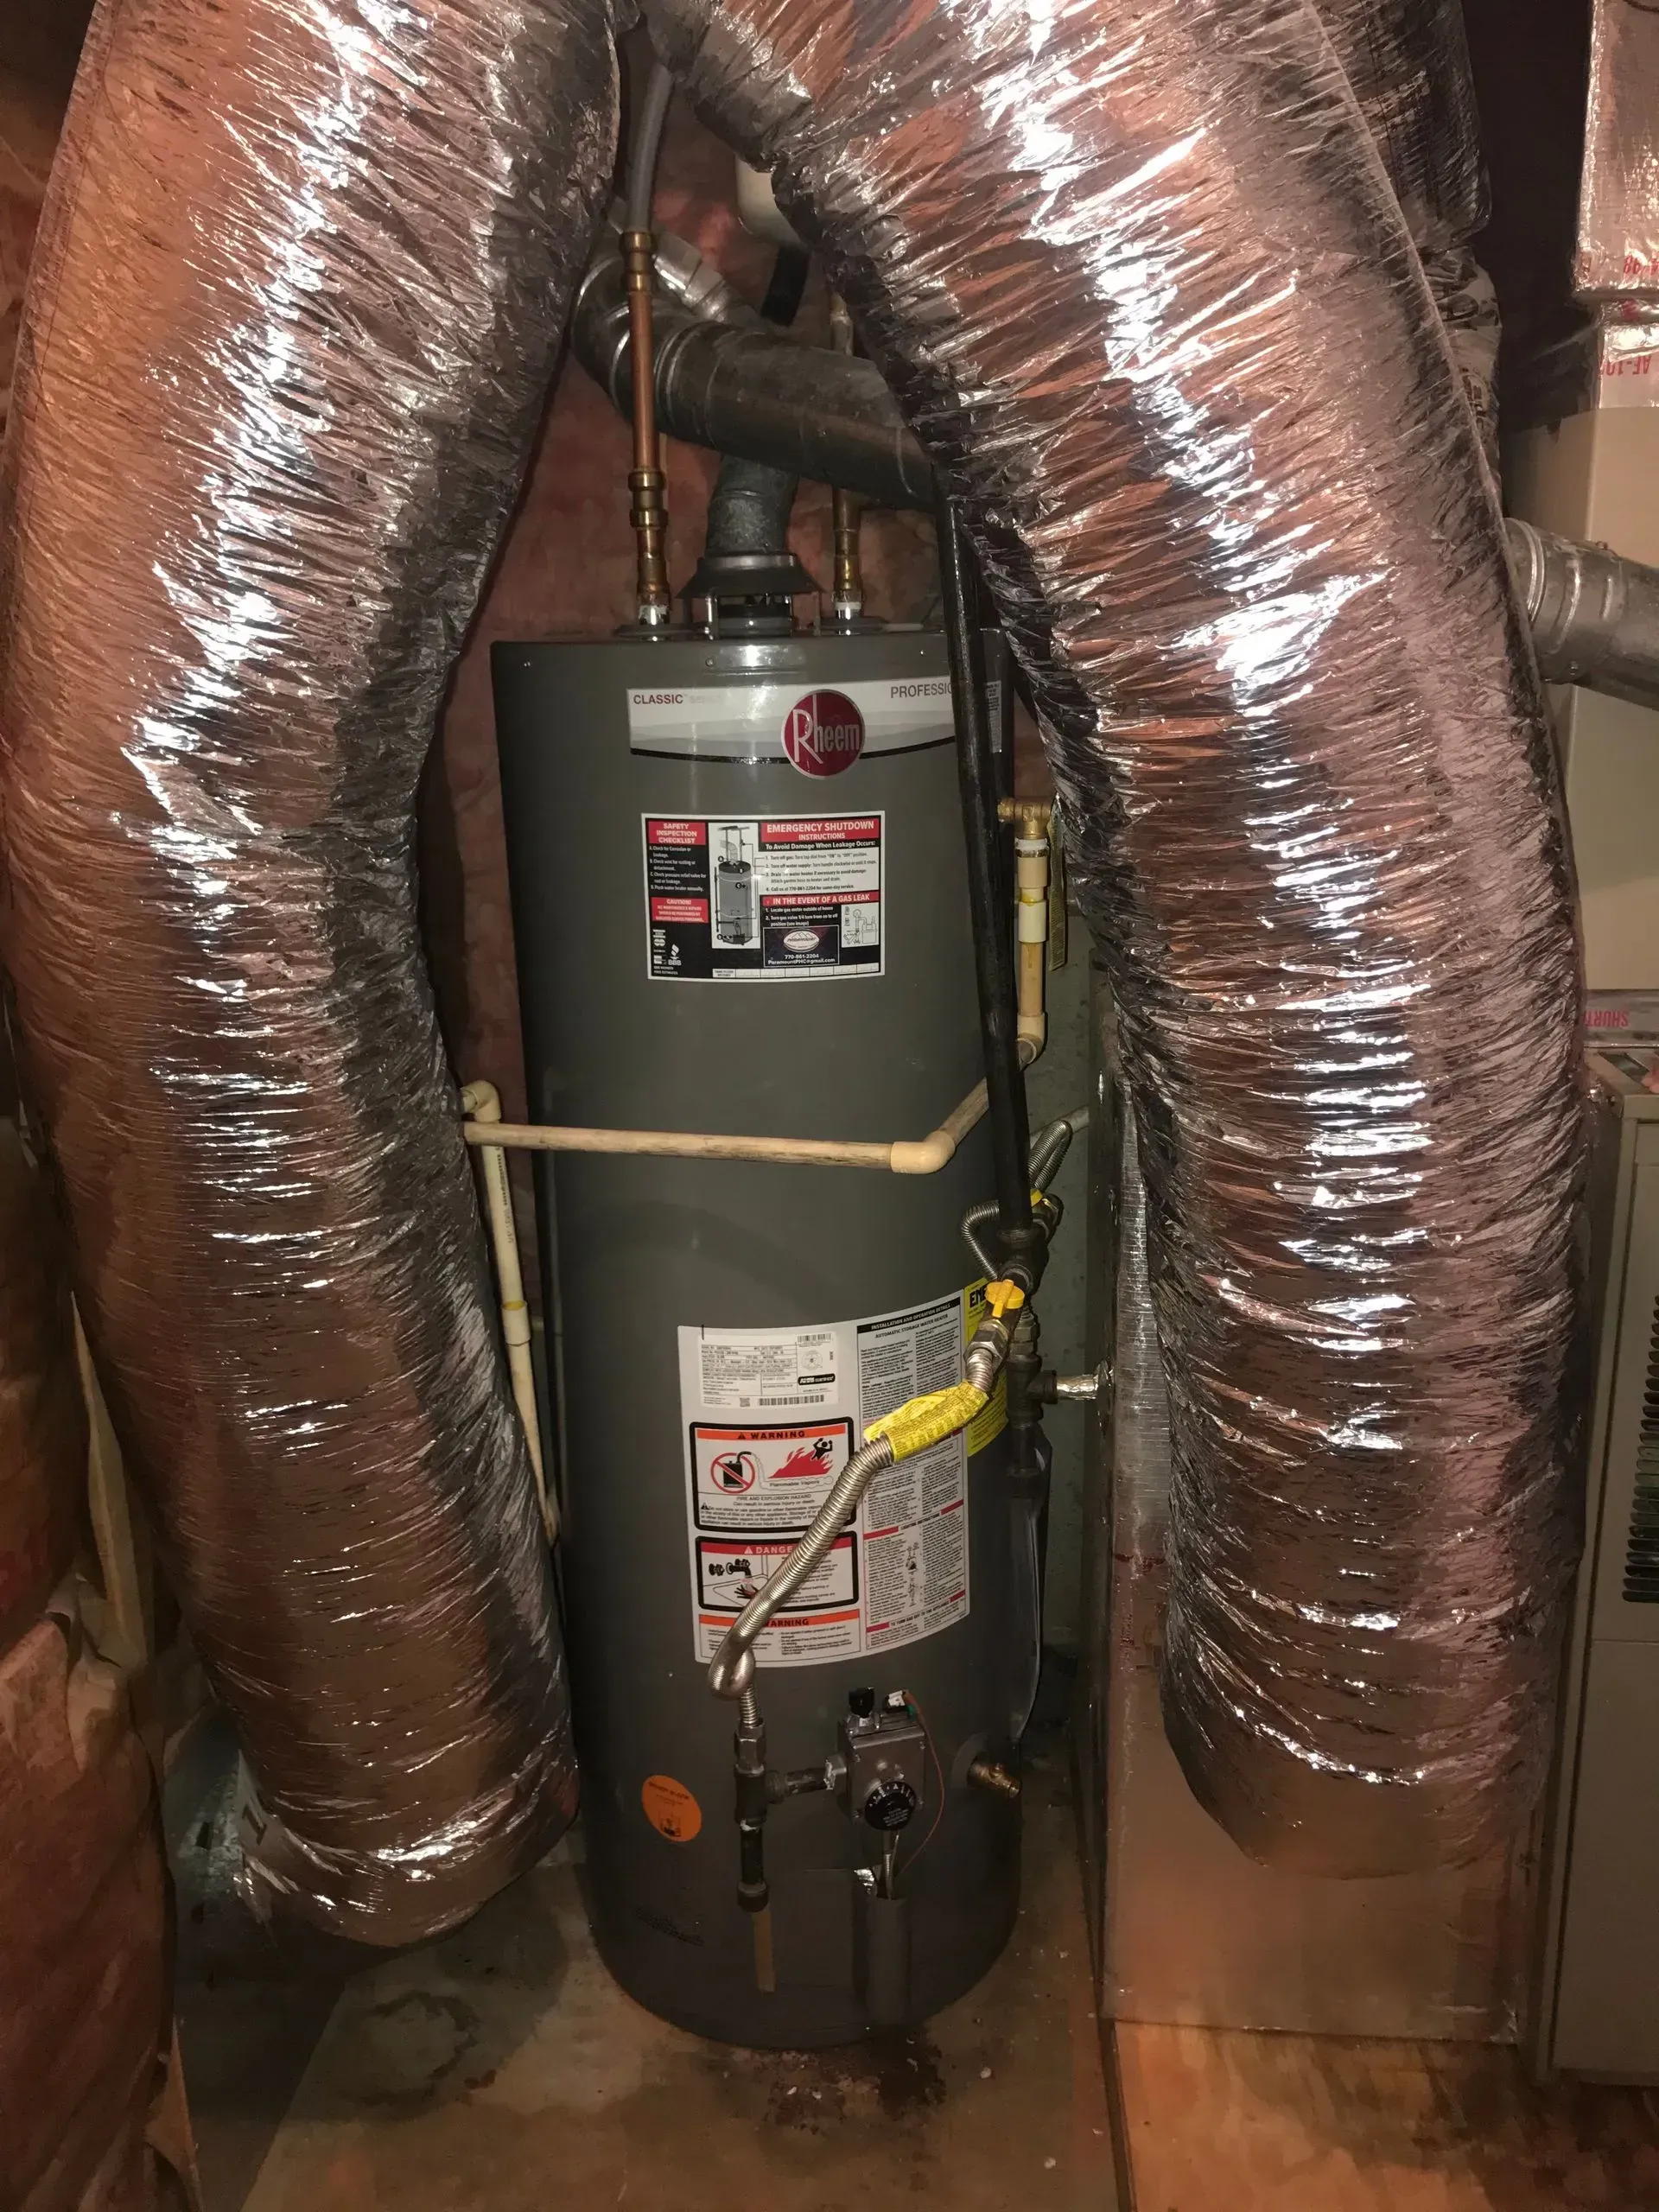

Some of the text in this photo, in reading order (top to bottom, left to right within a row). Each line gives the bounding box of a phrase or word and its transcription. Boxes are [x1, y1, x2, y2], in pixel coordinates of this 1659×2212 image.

[1602, 354, 1652, 376] AF-10
[633, 694, 683, 704] CLASSIC
[891, 683, 952, 699] PROFESSIO
[792, 694, 860, 764] Rheem
[766, 820, 874, 834] EMERGENCY SHUTDOWN
[798, 832, 845, 841] INSTRUCTIONS
[969, 1285, 987, 1308] ENE
[871, 1319, 903, 1330] INSTALLATION
[912, 1310, 935, 1320] OPERATION
[875, 1329, 900, 1338] AUTOMATIC
[901, 1324, 919, 1332] STORAGE
[934, 1313, 948, 1322] HEATER
[750, 1430, 805, 1440] WARNING
[756, 1546, 793, 1554] DANGE
